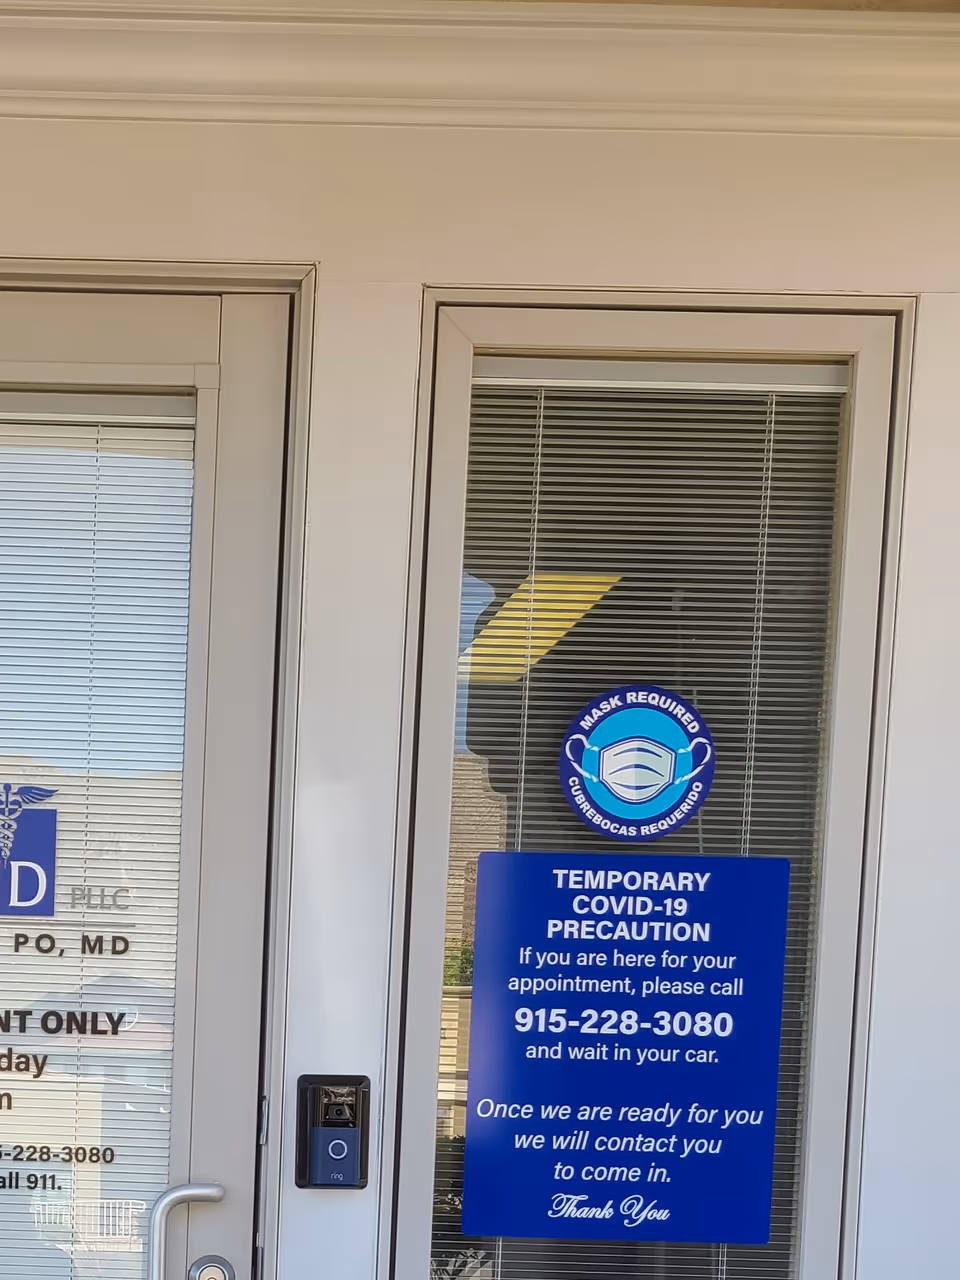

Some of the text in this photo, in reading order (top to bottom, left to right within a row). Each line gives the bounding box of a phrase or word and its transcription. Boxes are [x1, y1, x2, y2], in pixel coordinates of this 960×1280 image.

[580, 691, 700, 734] MASK REQUIRED
[568, 776, 703, 836] CUBREBOCAS REQUERIDO
[552, 869, 712, 892] TEMPORARY
[70, 886, 131, 910] PLLC
[572, 895, 688, 917] COVID-19
[547, 919, 711, 942] PRECAUTION
[14, 932, 65, 957] PO,
[81, 934, 130, 955] MD
[519, 946, 737, 973] If you are here for your
[508, 973, 744, 998] appointment, please call
[40, 1010, 127, 1036] ONLY
[514, 1007, 734, 1037] 915-228-3080
[525, 1042, 720, 1066] and wait in your car.
[476, 1098, 765, 1130] Once we are ready for you
[514, 1130, 723, 1159] we will contact you
[26, 1172, 62, 1191] 911.
[330, 1172, 344, 1181] ring
[553, 1161, 672, 1183] to come in.
[547, 1192, 671, 1228] Thank You
